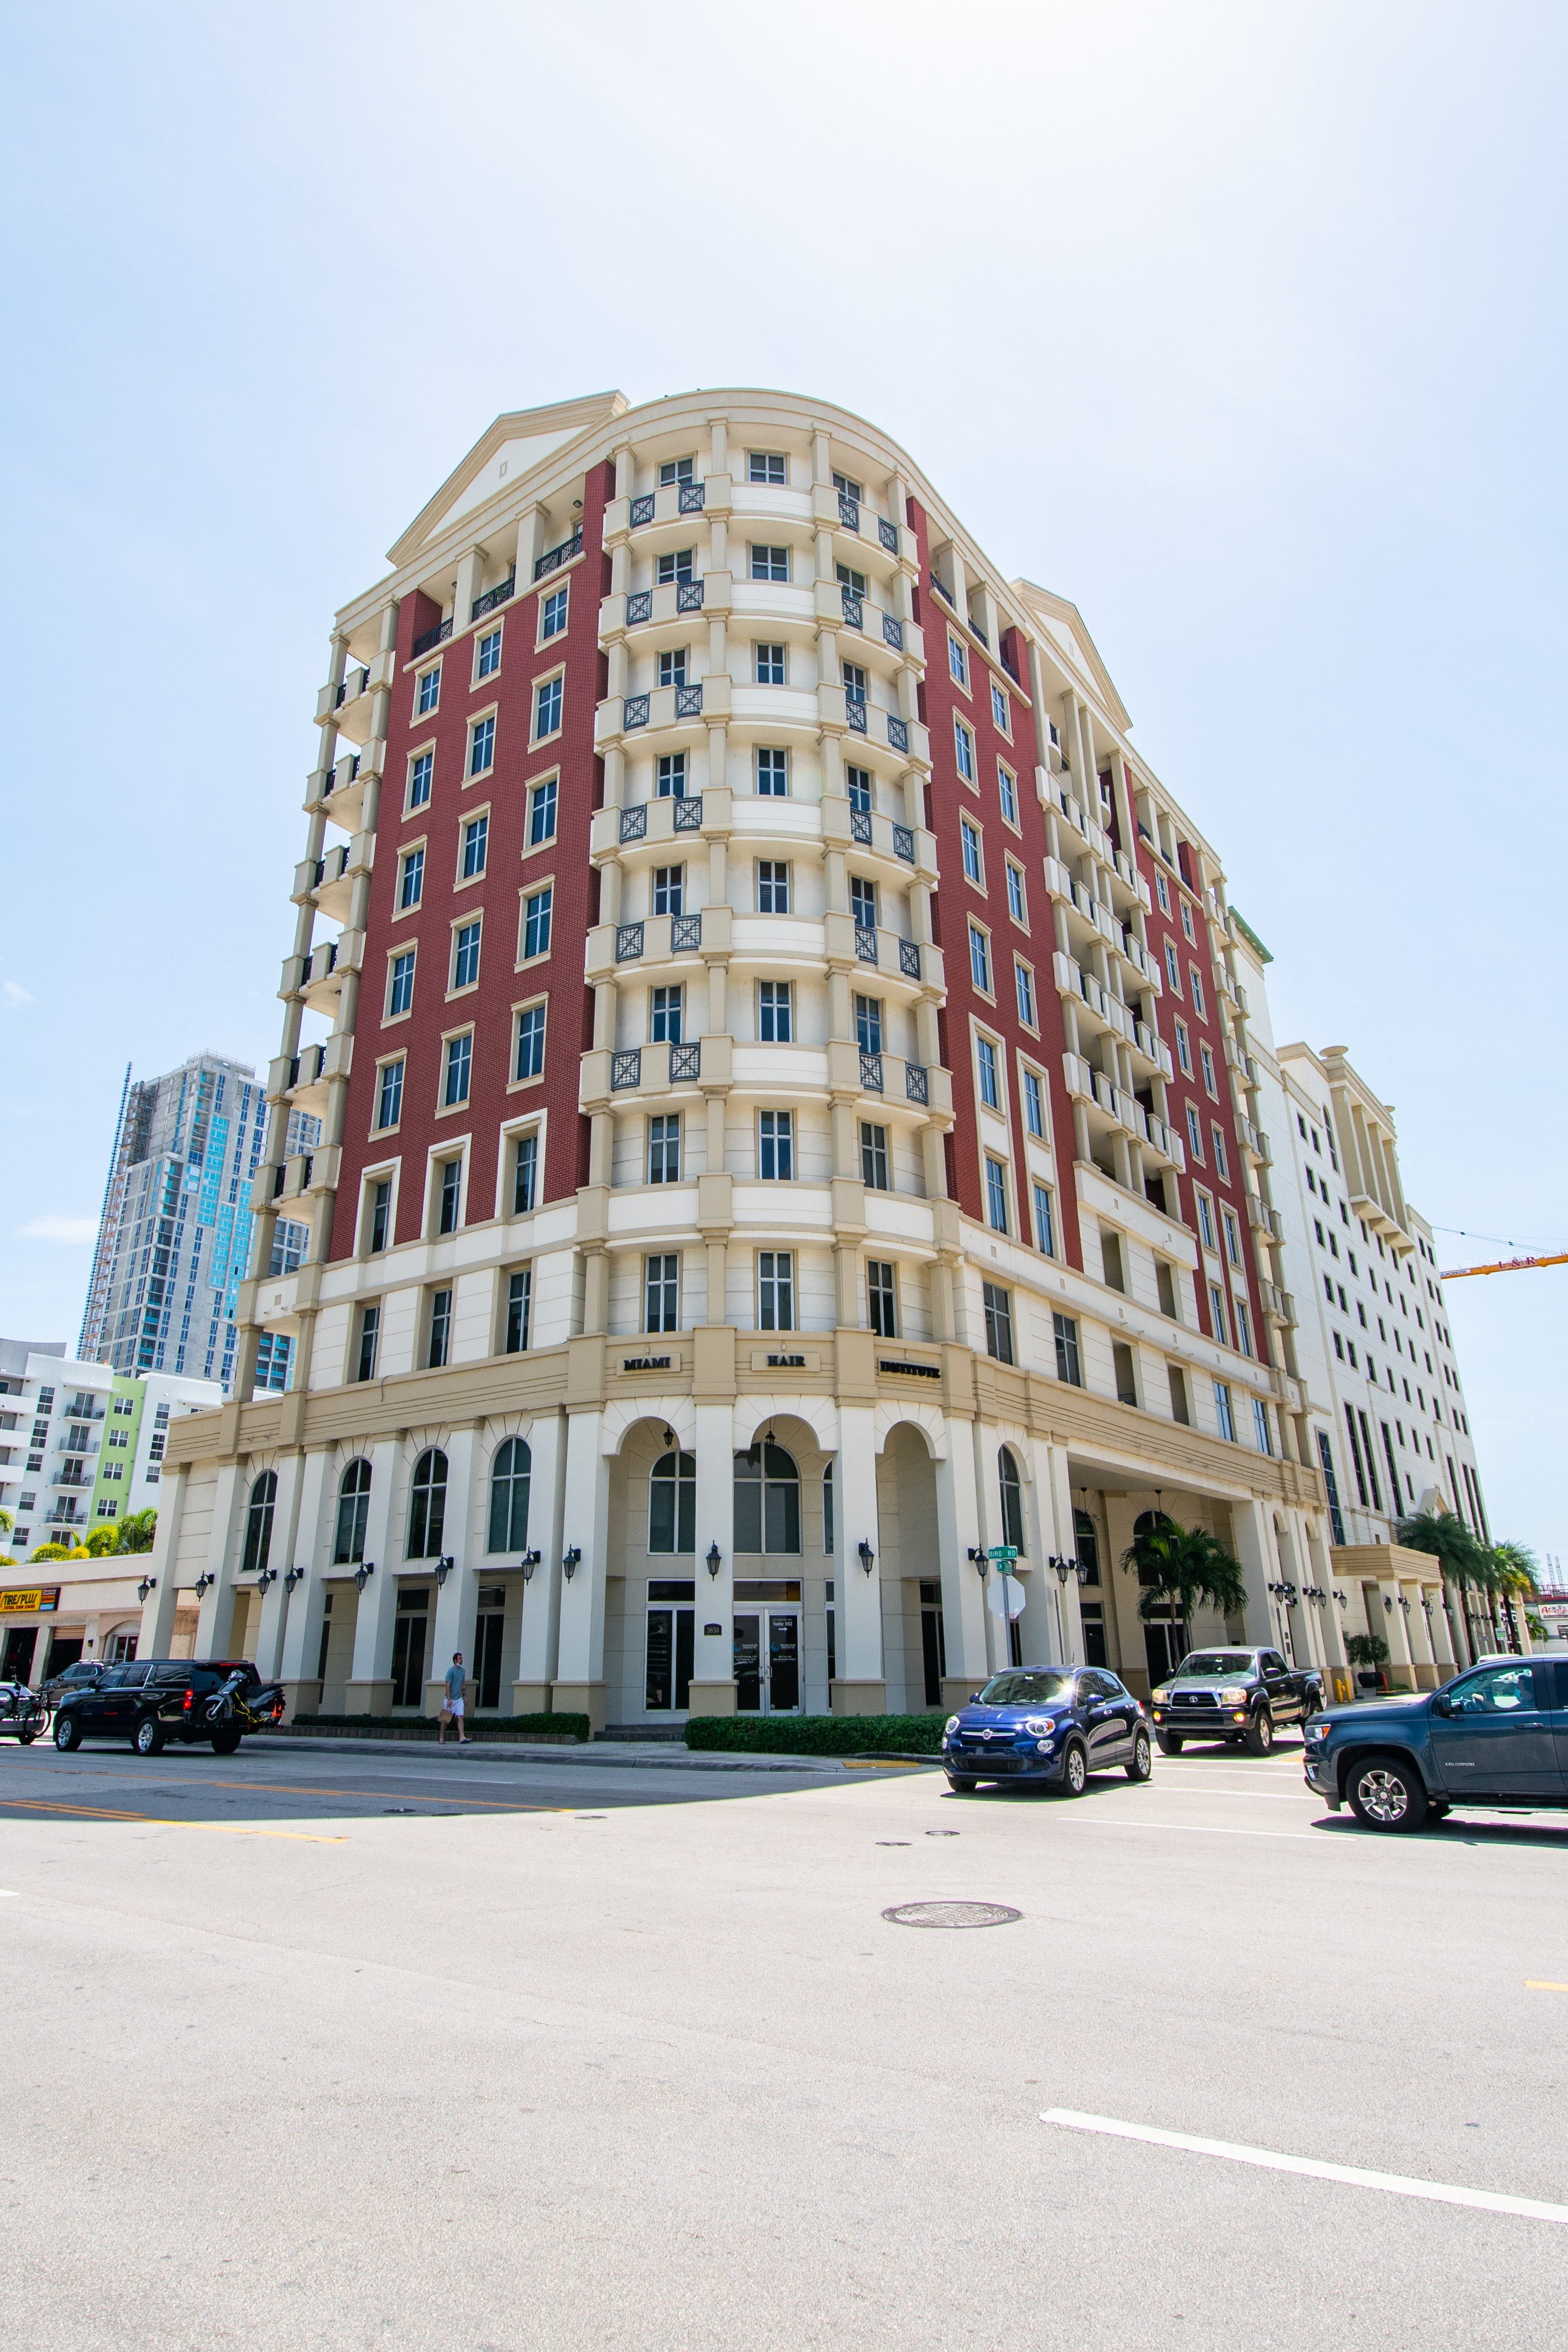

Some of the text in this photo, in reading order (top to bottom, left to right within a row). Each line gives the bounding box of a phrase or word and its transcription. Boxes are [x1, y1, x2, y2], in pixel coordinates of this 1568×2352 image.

[1526, 1257, 1536, 1265] R
[623, 1356, 671, 1371] MIAMI
[767, 1355, 806, 1366] HAIR
